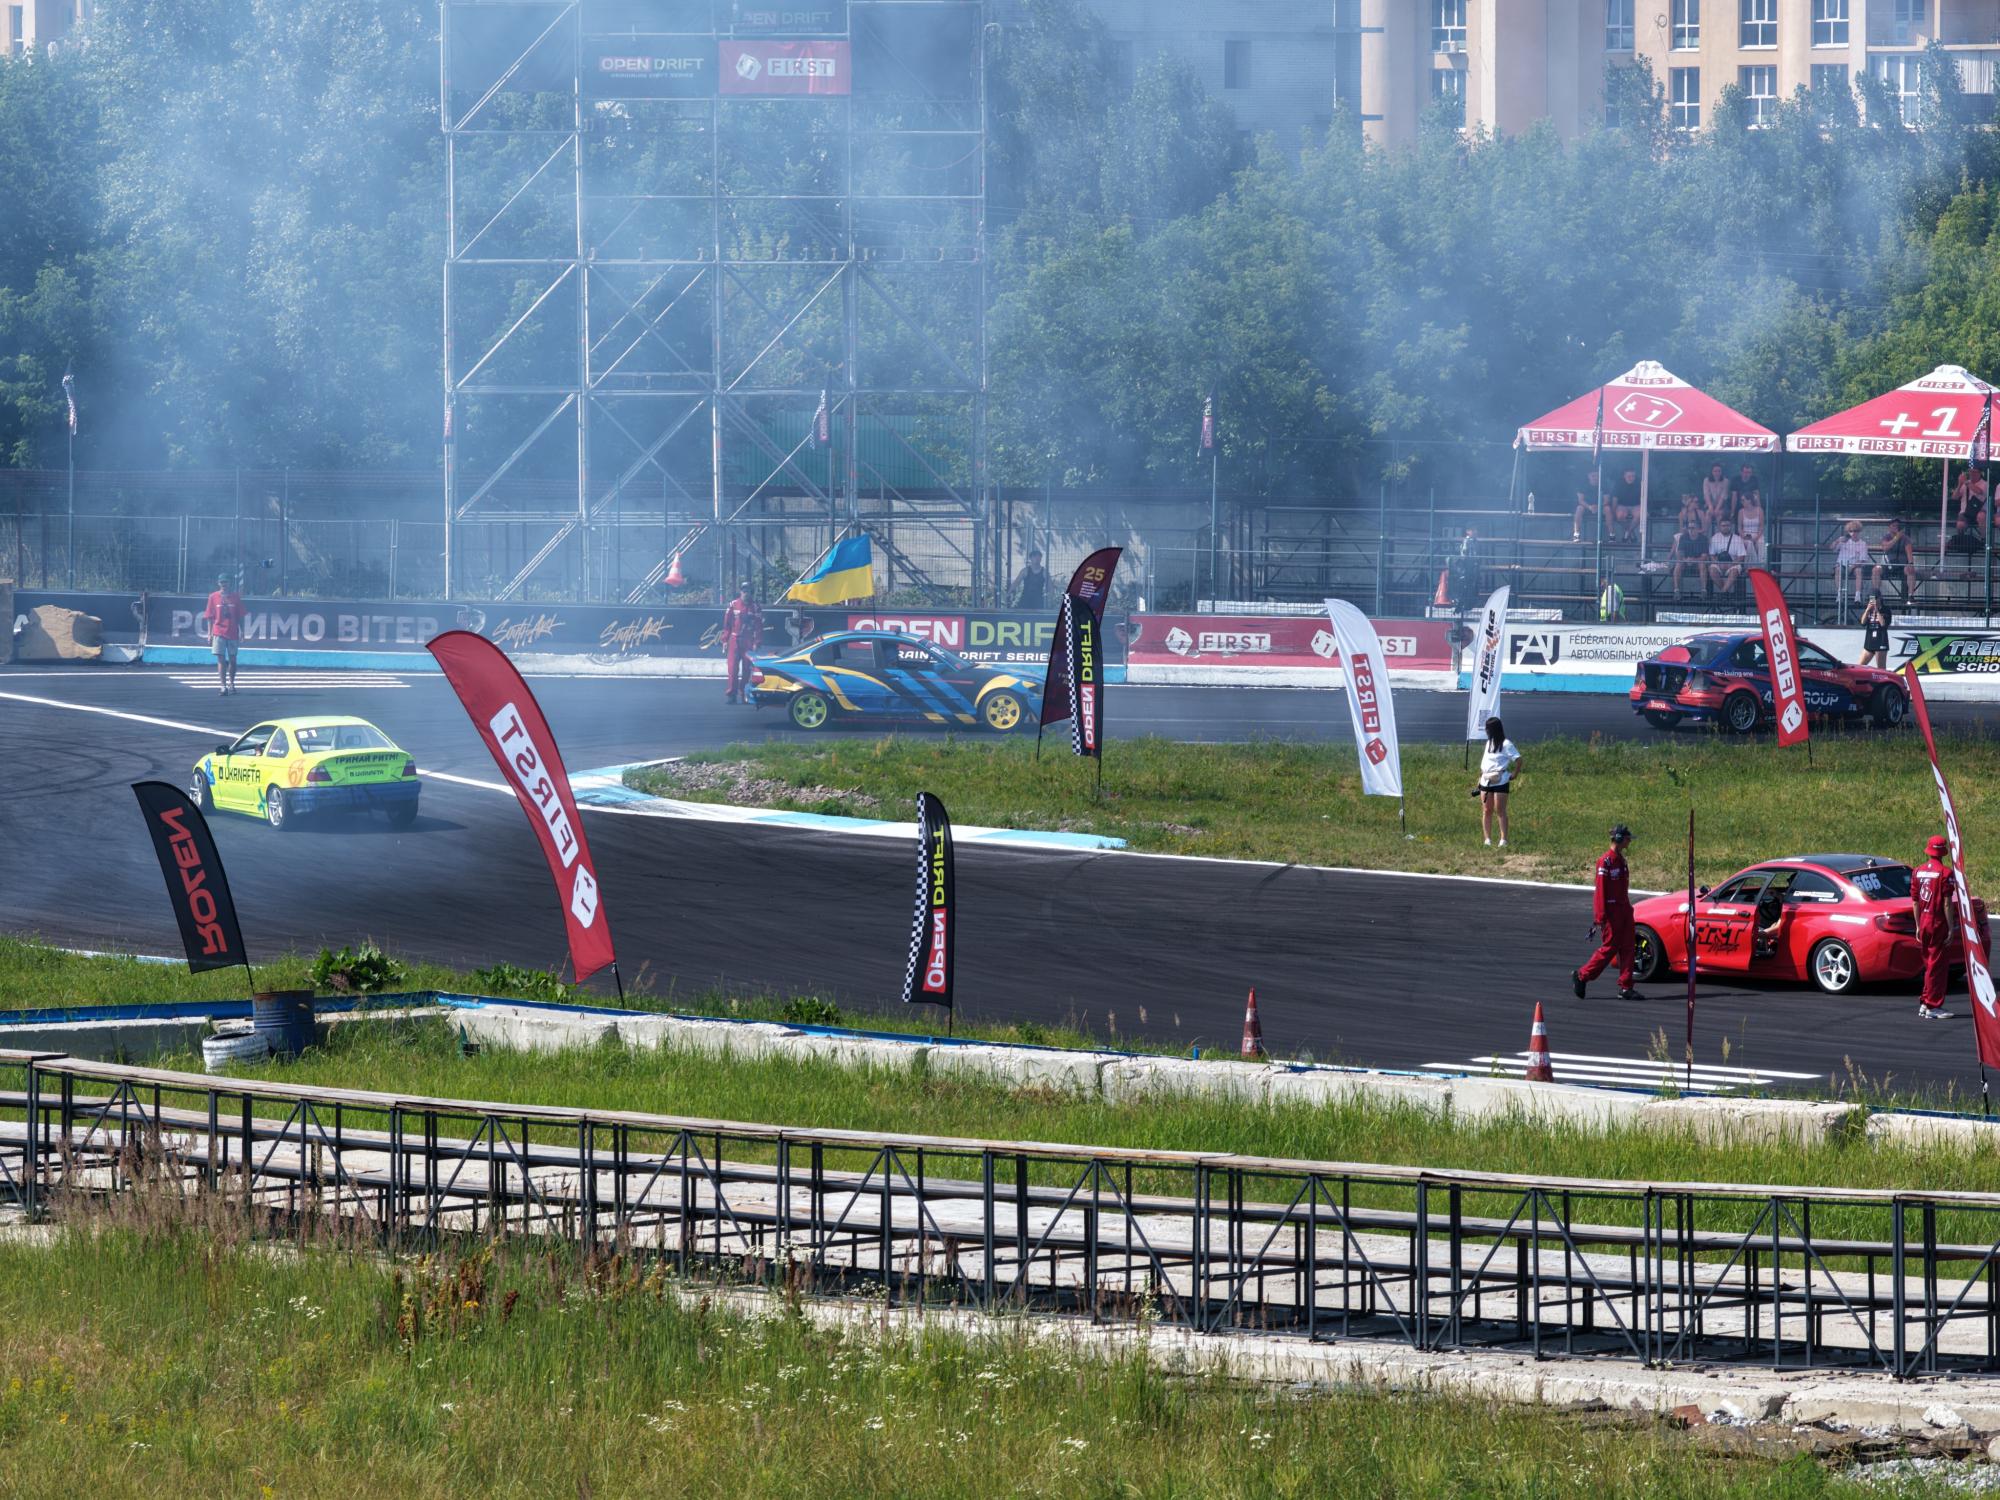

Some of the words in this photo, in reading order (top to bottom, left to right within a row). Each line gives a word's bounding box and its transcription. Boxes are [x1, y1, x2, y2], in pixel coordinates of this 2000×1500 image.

[601, 58, 649, 71] OPEN
[654, 58, 704, 71] DRIFT
[772, 61, 831, 74] FIRST
[1919, 382, 1965, 390] FIRST
[1532, 433, 1575, 442] FIRST
[1603, 434, 1638, 444] IRST
[1659, 436, 1703, 445] FIRST
[1723, 438, 1767, 447] FIRST
[1800, 439, 1842, 449] FIRST
[1862, 440, 1904, 451] FIRST
[1924, 443, 1967, 454] FIRST
[1084, 567, 1105, 581] 25
[171, 611, 326, 640] РОИМО
[970, 621, 1057, 647] DRIF
[1569, 634, 1624, 645] FÉDÉRATION
[1203, 635, 1267, 650] FIRST
[1007, 653, 1050, 661] SERIE
[1570, 650, 1643, 661] АВТОМОБІЛЬНА
[1852, 873, 1881, 891] 666
